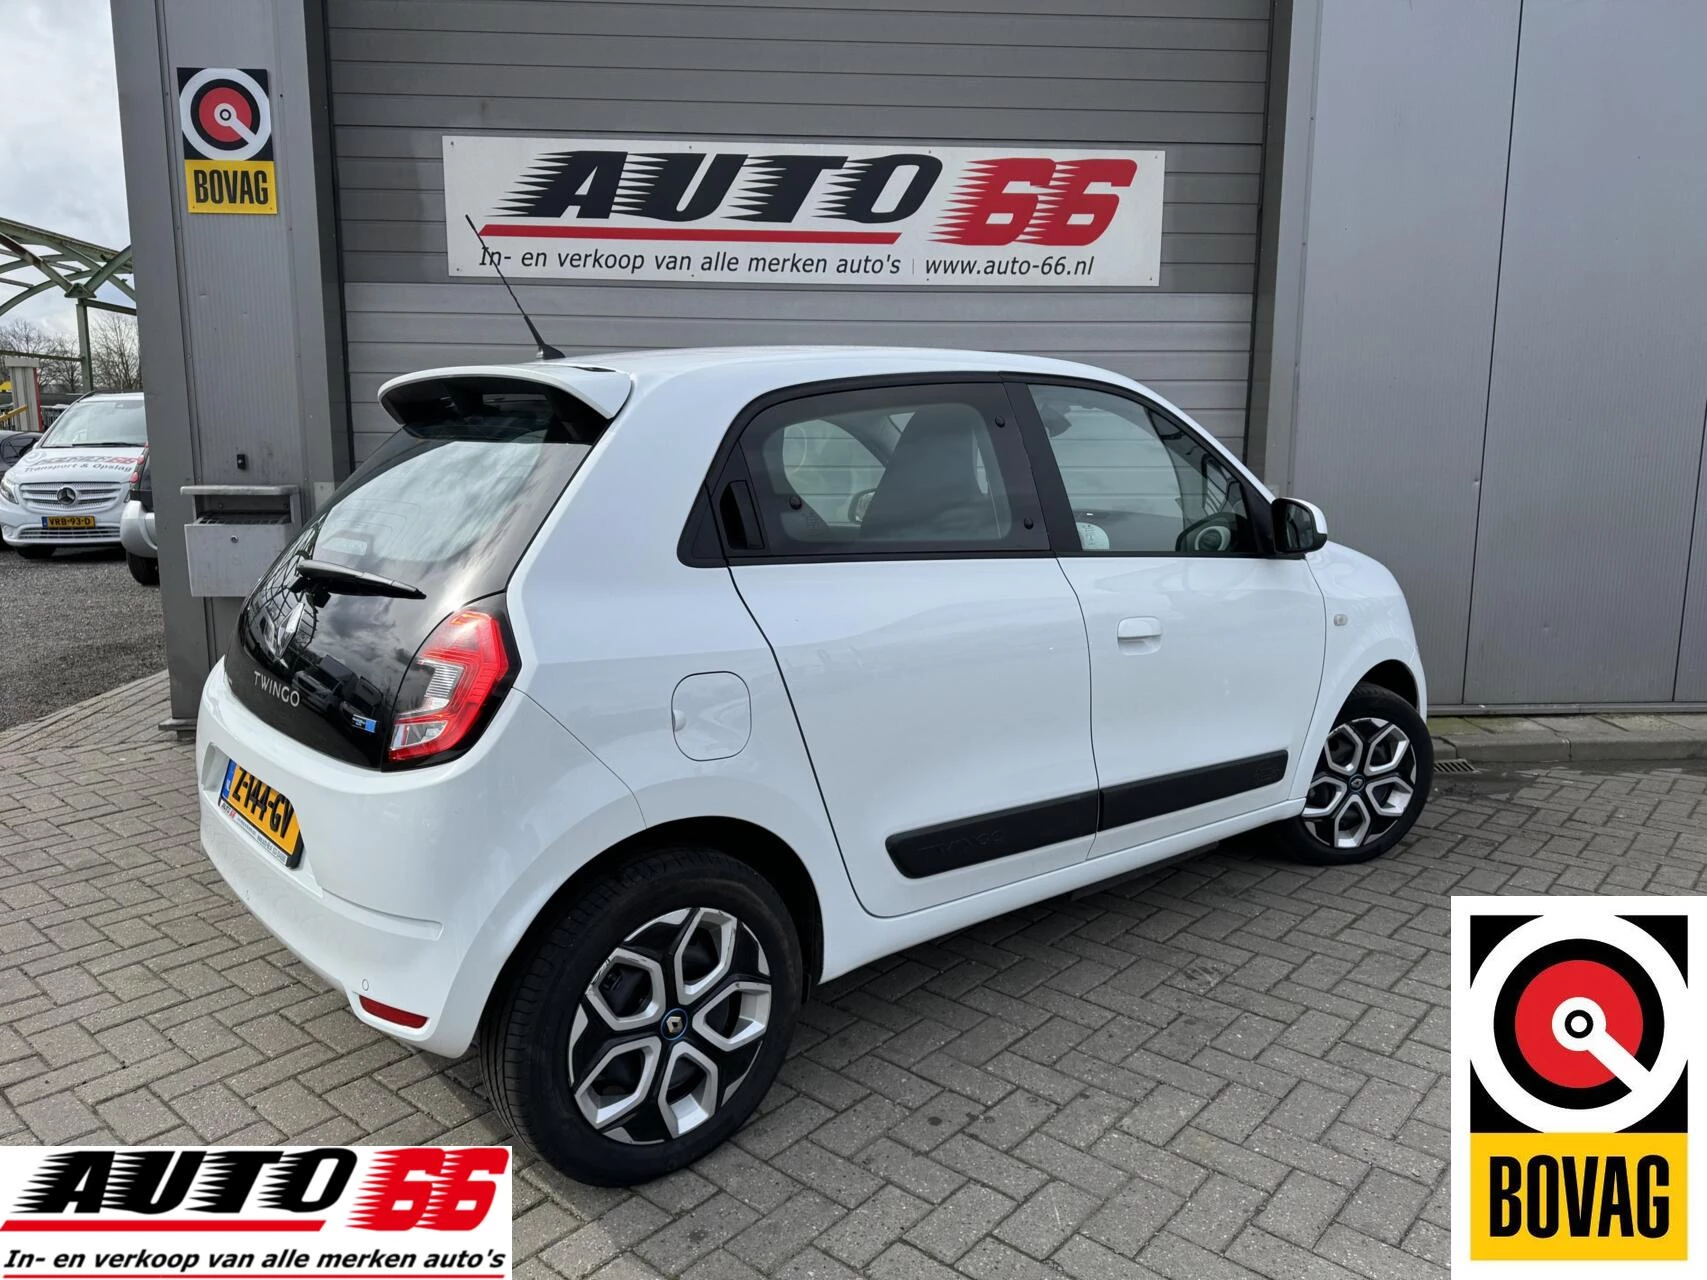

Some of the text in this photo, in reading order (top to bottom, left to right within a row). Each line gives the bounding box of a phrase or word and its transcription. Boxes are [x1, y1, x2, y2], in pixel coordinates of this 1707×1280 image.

[193, 169, 269, 205] BOVAG
[483, 150, 1138, 246] AUTO 66
[479, 247, 1095, 276] In- en verkoop van alle merken auto's www.auto-66.nl
[24, 463, 77, 473] Transport
[93, 463, 133, 473] Opslag
[254, 672, 299, 707] TWINGO
